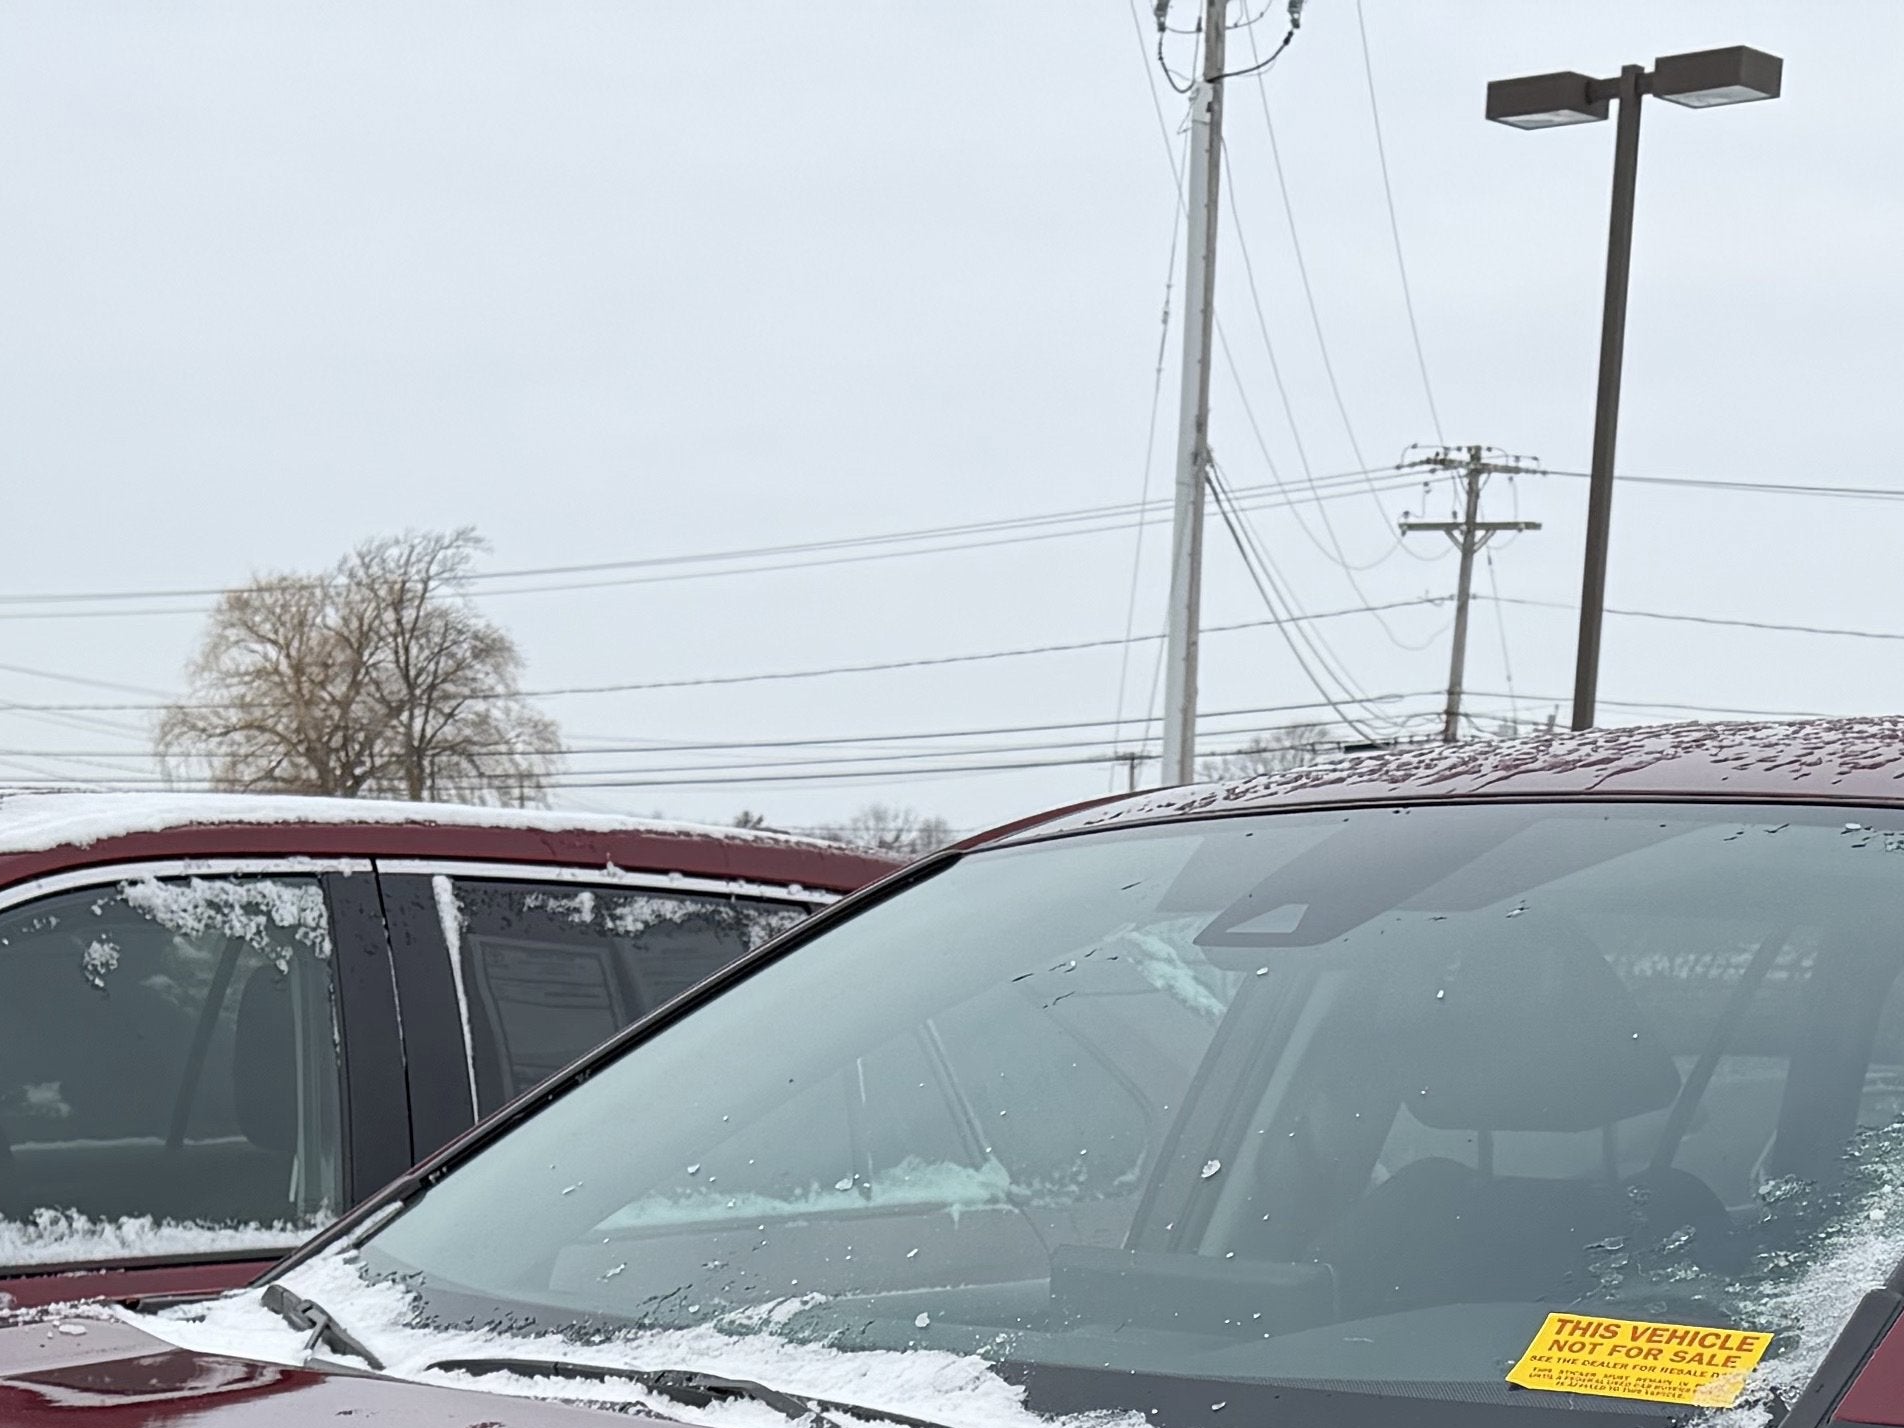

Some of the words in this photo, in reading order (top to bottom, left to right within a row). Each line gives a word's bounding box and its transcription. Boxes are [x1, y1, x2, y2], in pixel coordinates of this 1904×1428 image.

[1555, 1318, 1621, 1340] THIS
[1630, 1325, 1761, 1353] VEHICLE
[1529, 1355, 1553, 1363] SEE
[1557, 1357, 1578, 1365] THE
[1581, 1359, 1629, 1370] DEALER
[1632, 1363, 1657, 1373] FOR
[1659, 1366, 1709, 1378] RESALE
[1547, 1339, 1603, 1355] NOT
[1607, 1345, 1663, 1362] FOR
[1669, 1350, 1742, 1369] SALE
